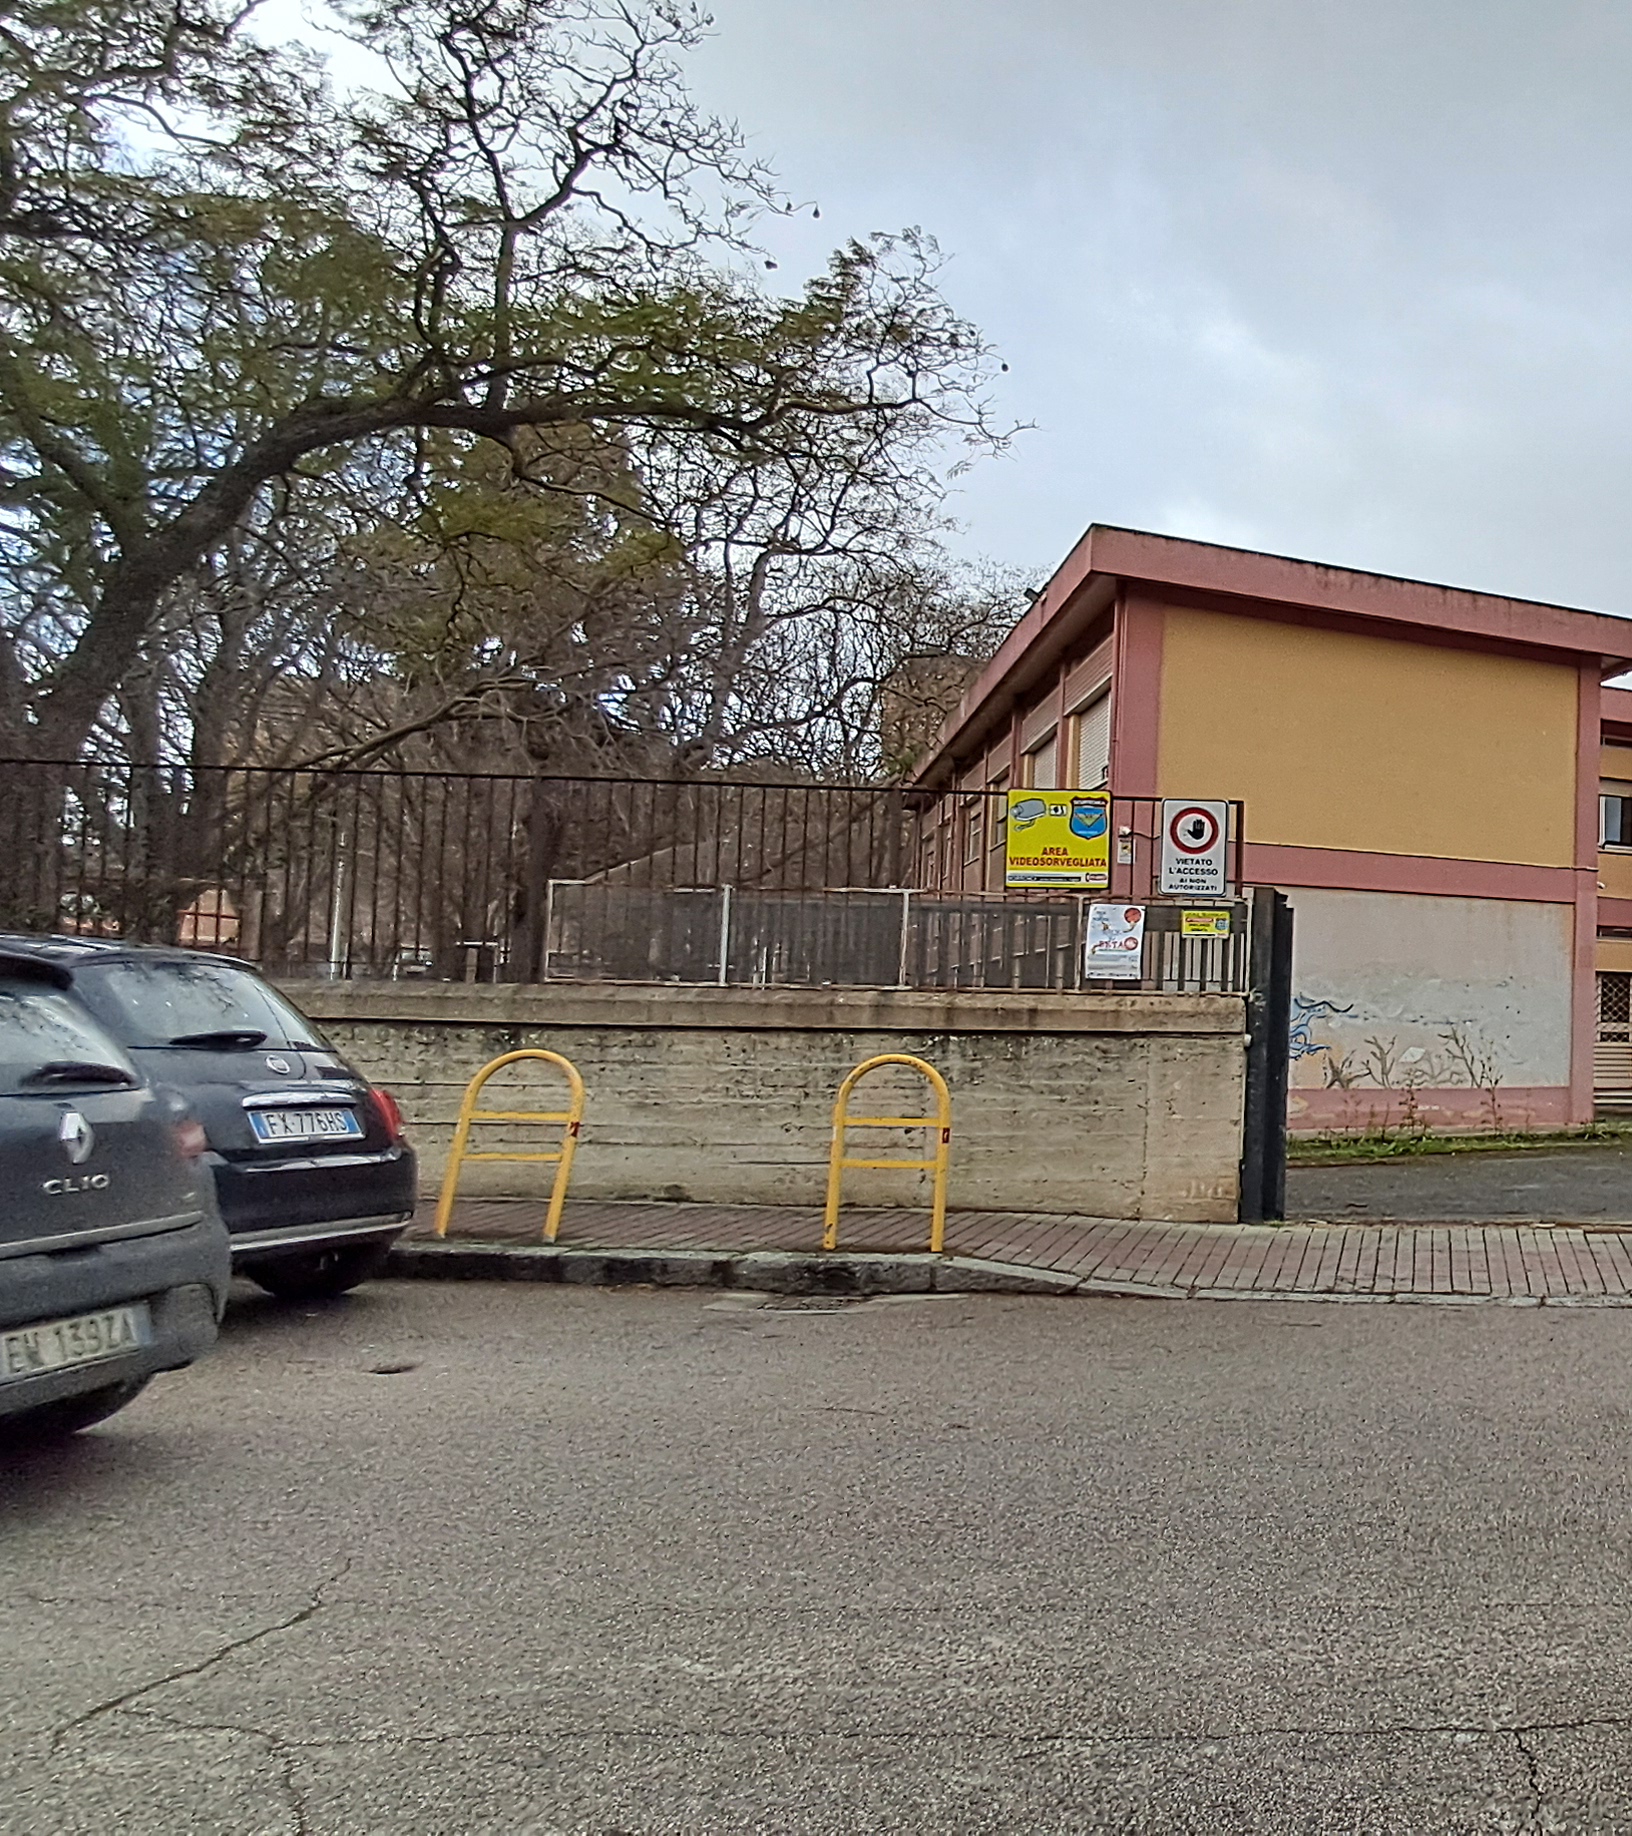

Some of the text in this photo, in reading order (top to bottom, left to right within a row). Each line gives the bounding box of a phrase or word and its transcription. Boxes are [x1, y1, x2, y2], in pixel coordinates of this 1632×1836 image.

[1041, 846, 1068, 856] AREA
[1009, 857, 1107, 867] VIDEOSORVEGLIATA
[1175, 858, 1213, 866] VIETATO
[1168, 866, 1219, 876] L'ACCESSO
[43, 1174, 109, 1195] CLIO
